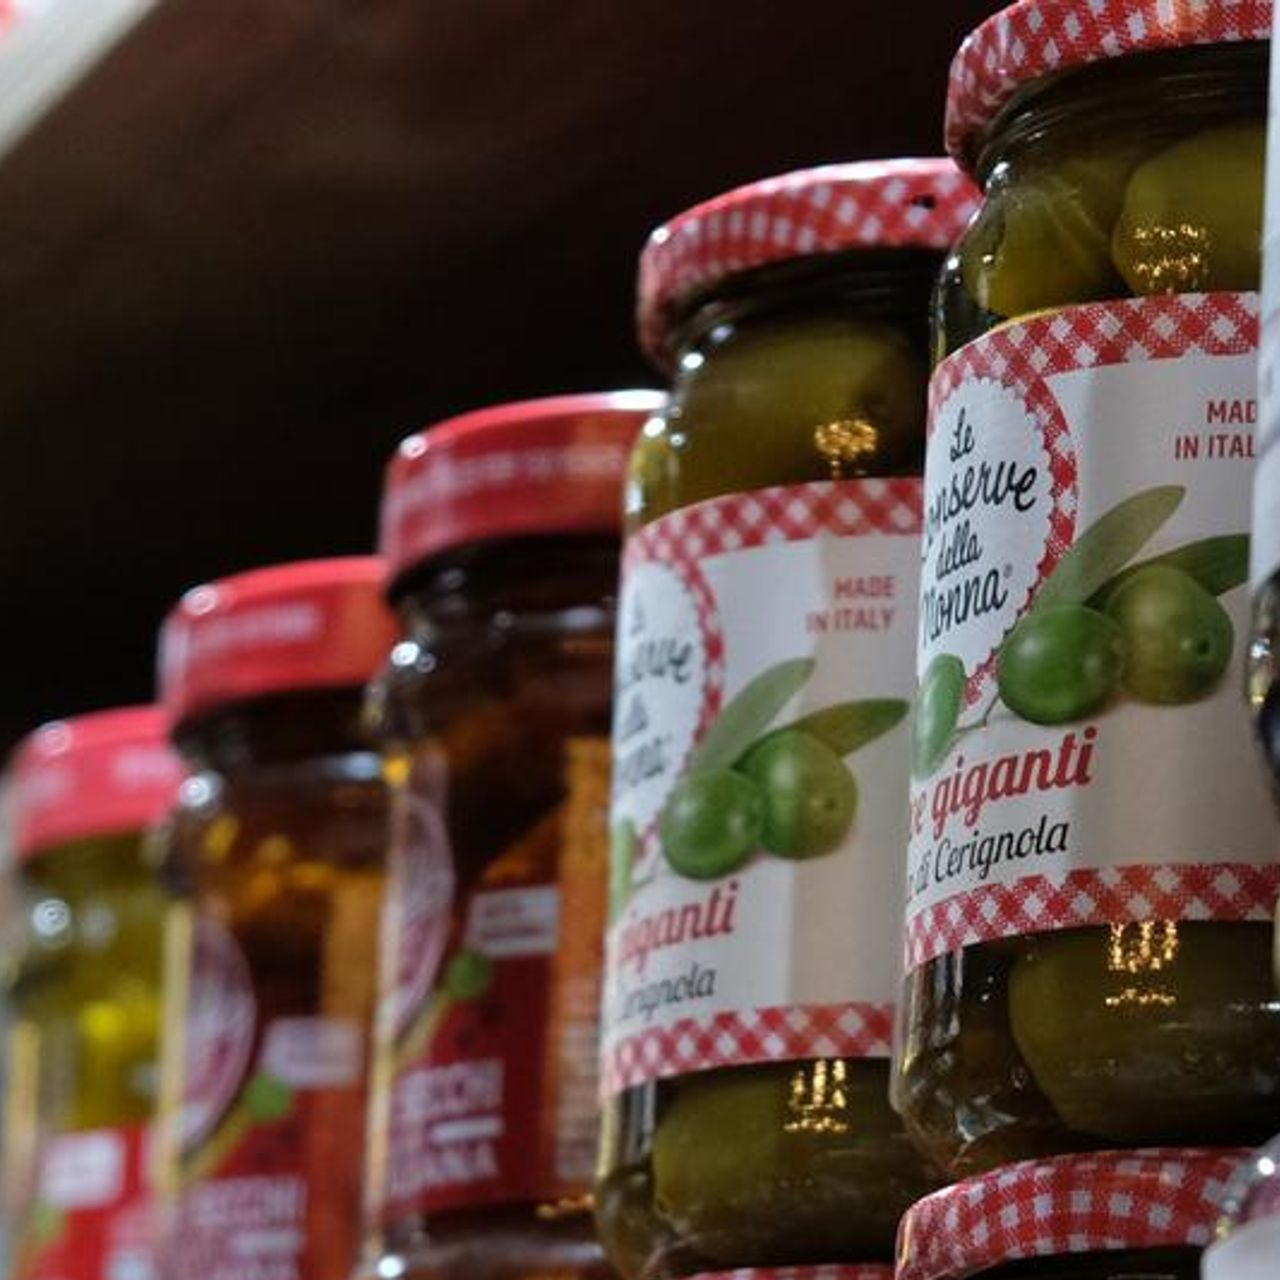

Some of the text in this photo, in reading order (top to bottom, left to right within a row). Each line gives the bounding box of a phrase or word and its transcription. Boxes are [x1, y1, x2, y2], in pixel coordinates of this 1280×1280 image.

[1175, 434, 1257, 460] IN ITAL
[931, 726, 1097, 841] giganti
[934, 814, 1070, 882] Cerignola
